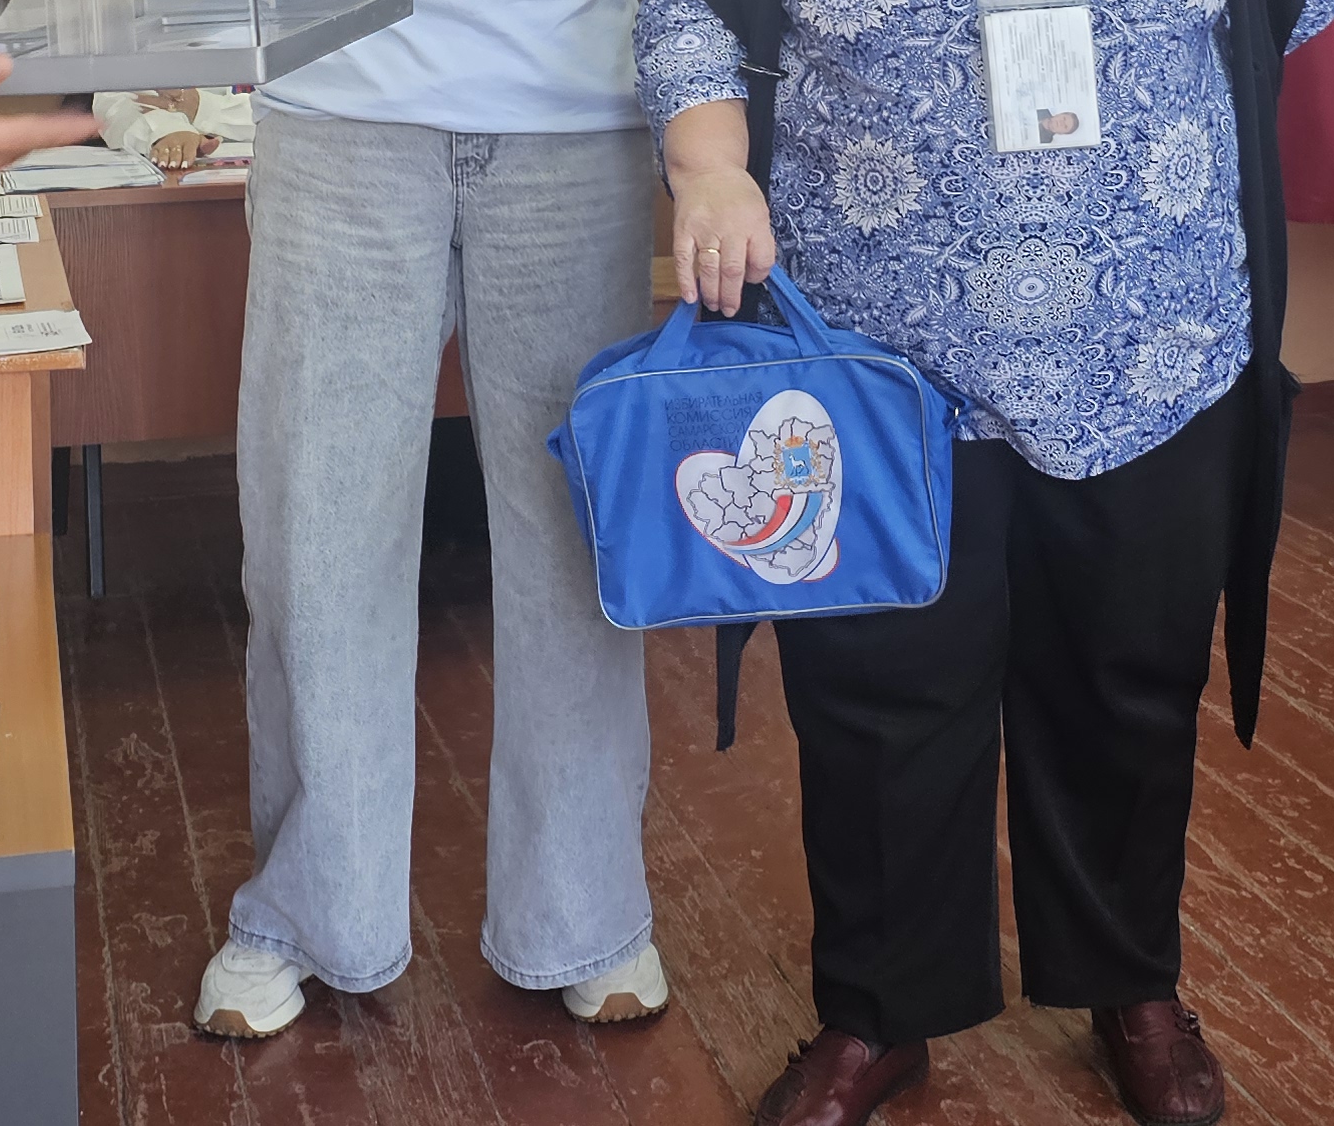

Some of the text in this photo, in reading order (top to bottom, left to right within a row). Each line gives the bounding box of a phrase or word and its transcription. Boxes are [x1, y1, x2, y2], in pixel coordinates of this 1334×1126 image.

[664, 391, 763, 411] ИЗБИРАТЕЛЬНАЯ
[667, 405, 753, 424] КОМИССИЯ
[669, 435, 740, 452] ОБЛАСТИ
